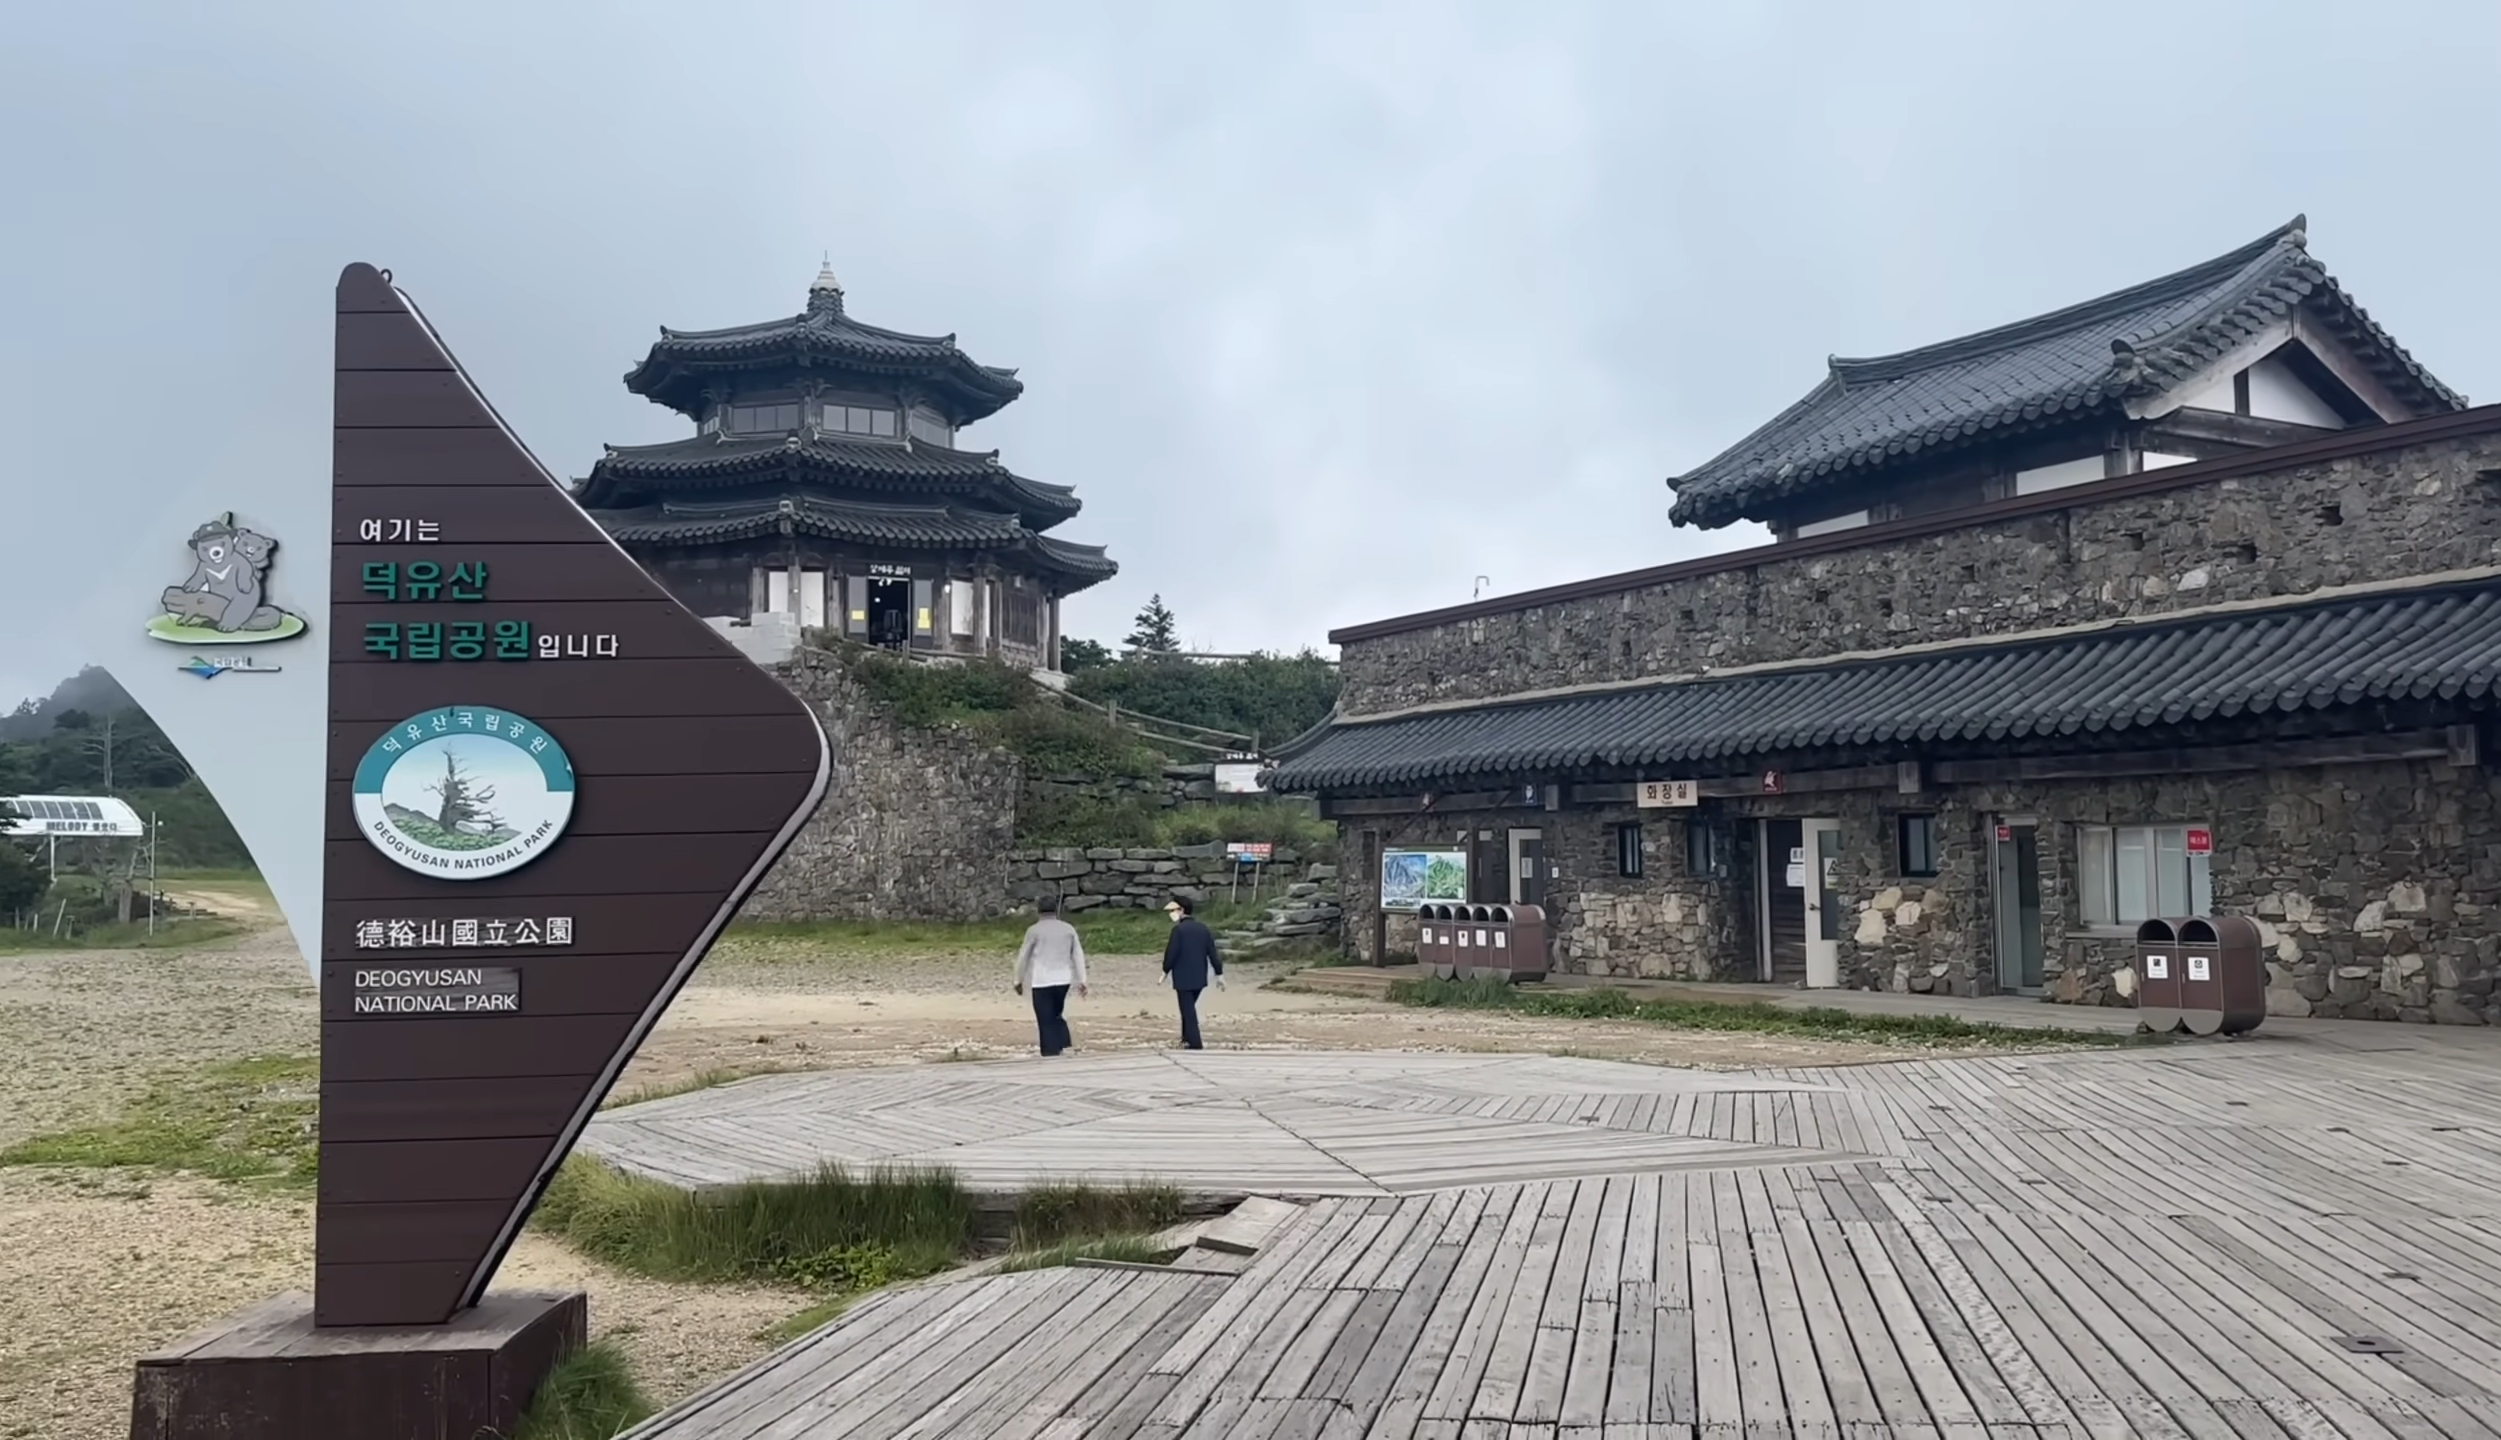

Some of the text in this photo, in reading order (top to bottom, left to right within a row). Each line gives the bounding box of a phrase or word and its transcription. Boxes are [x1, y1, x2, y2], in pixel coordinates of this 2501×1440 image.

[359, 518, 441, 542] 여기는
[361, 561, 488, 600] 덕유산
[363, 620, 619, 660] 국립공원 입니다
[1646, 783, 1688, 800] 화장실
[373, 819, 554, 870] DEOGYUSAN NATIONAL PARK
[355, 916, 573, 949] 德裕山國立公園
[354, 969, 483, 988] DEOGYUSAN
[354, 994, 520, 1013] NATIONAL PARK
